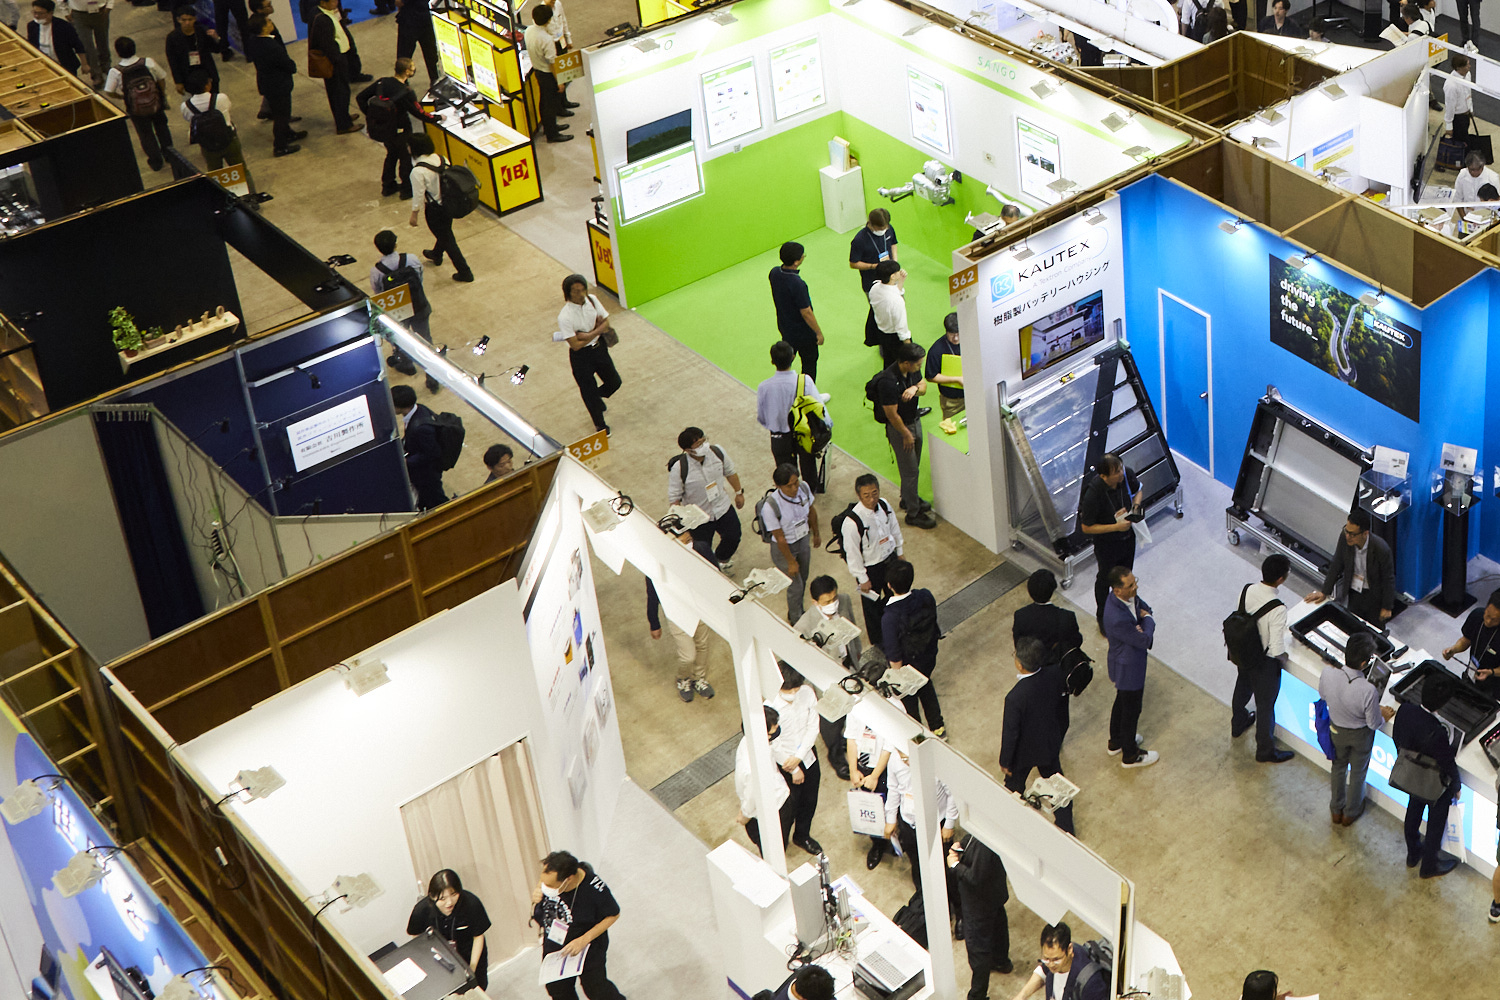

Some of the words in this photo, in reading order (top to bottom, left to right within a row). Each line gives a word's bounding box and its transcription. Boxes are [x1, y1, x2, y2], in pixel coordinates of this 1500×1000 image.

[559, 53, 579, 68] 361
[977, 56, 1016, 80] SANGO
[1017, 238, 1091, 282] KAUTEX
[951, 270, 976, 290] 362
[377, 290, 405, 310] 337
[993, 259, 1111, 328] 樹脂製バッテリーハウジング
[1280, 277, 1316, 308] driving
[1280, 293, 1299, 314] the
[1280, 308, 1318, 342] future_
[1373, 319, 1406, 343] KAUTEX
[572, 437, 603, 460] 336
